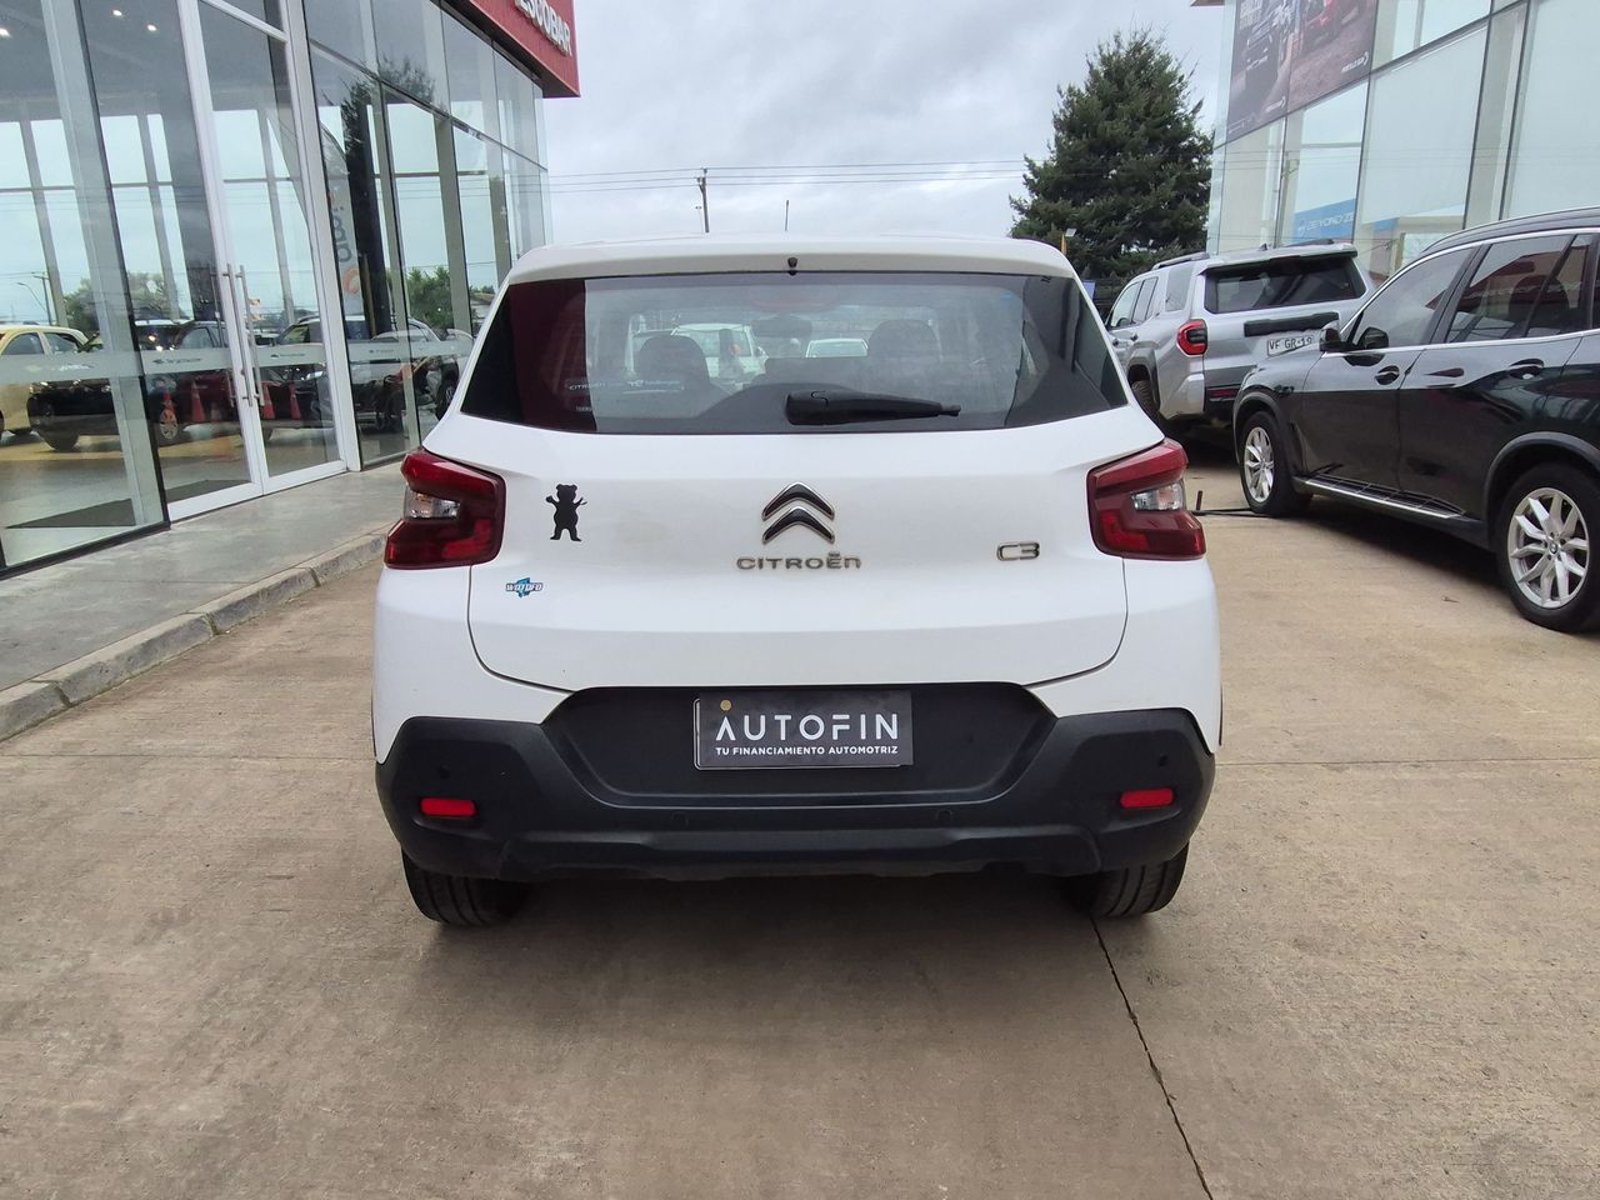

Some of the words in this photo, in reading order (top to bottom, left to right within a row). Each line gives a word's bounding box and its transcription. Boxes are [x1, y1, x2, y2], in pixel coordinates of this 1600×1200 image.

[997, 542, 1040, 561] C3
[715, 713, 899, 741] AUTOFIN
[715, 747, 730, 756] TU
[733, 746, 826, 755] FINANCIAMIENTO
[828, 745, 899, 755] AUTOMOTRIZ
